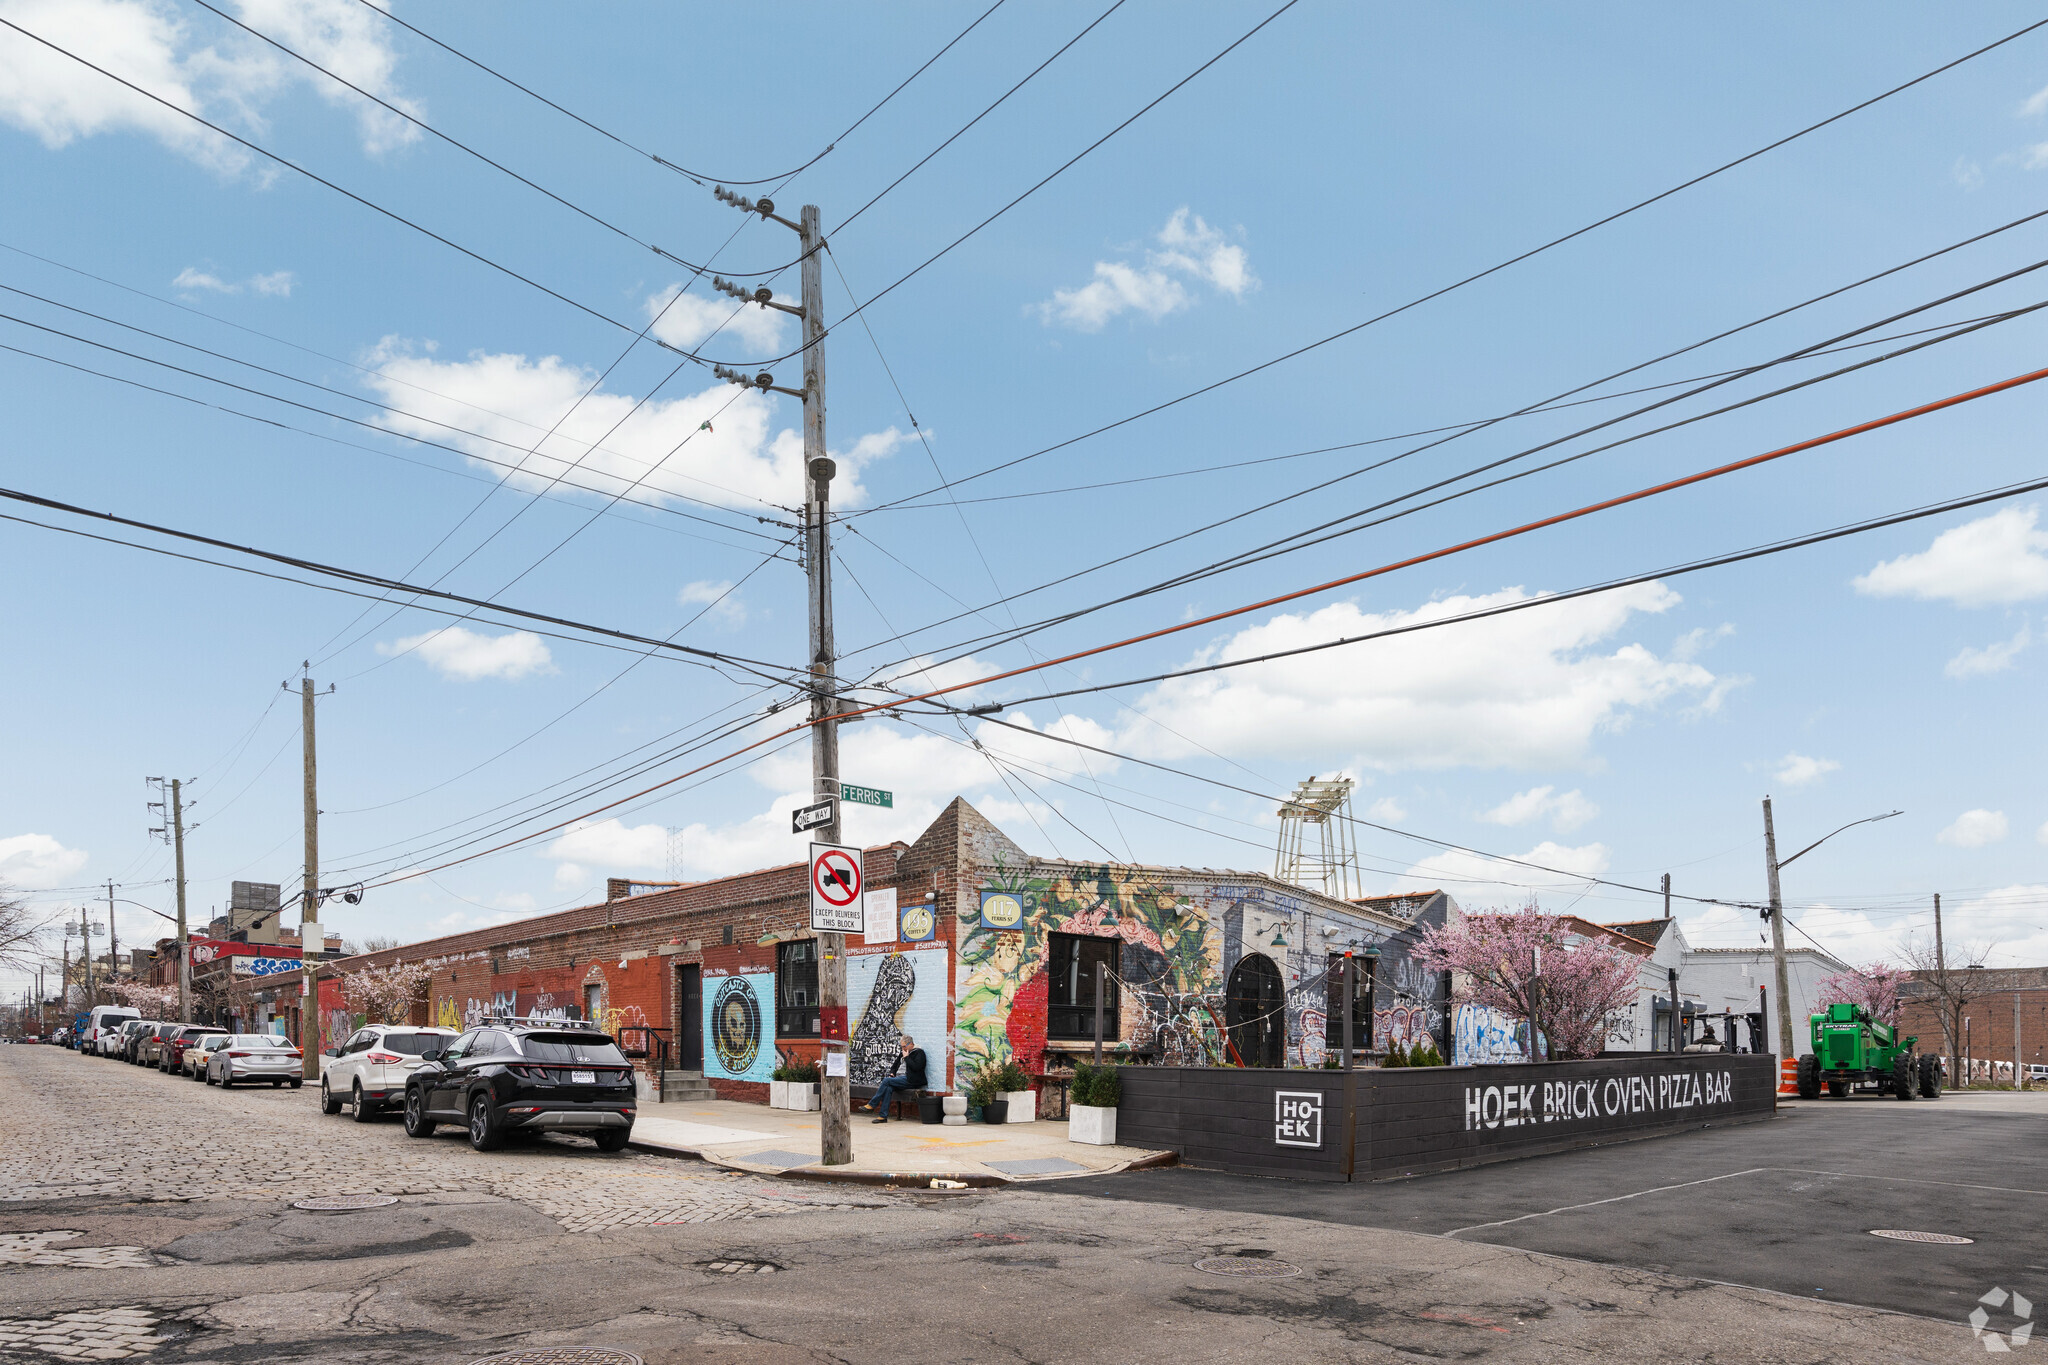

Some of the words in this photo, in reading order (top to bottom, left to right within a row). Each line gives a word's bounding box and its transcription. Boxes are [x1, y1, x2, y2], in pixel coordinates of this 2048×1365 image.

[842, 785, 881, 805] FERRIS
[883, 793, 891, 801] ST
[799, 814, 810, 826] ONE
[815, 808, 828, 821] WAY
[815, 908, 833, 917] EXCEPT
[835, 910, 861, 919] DELIVERIES
[992, 900, 1014, 916] 117
[822, 918, 835, 927] THIS
[837, 920, 855, 928] BLOCK
[907, 912, 928, 929] 195
[715, 979, 745, 1007] OUTCASTS
[1465, 1084, 1537, 1131] HOEK
[1543, 1079, 1600, 1123] BRICK
[1604, 1075, 1655, 1117] OVEN
[1659, 1072, 1703, 1109] PIZZA
[1706, 1070, 1732, 1105] BAR
[1283, 1101, 1313, 1119] HO
[1283, 1119, 1310, 1138] EK
